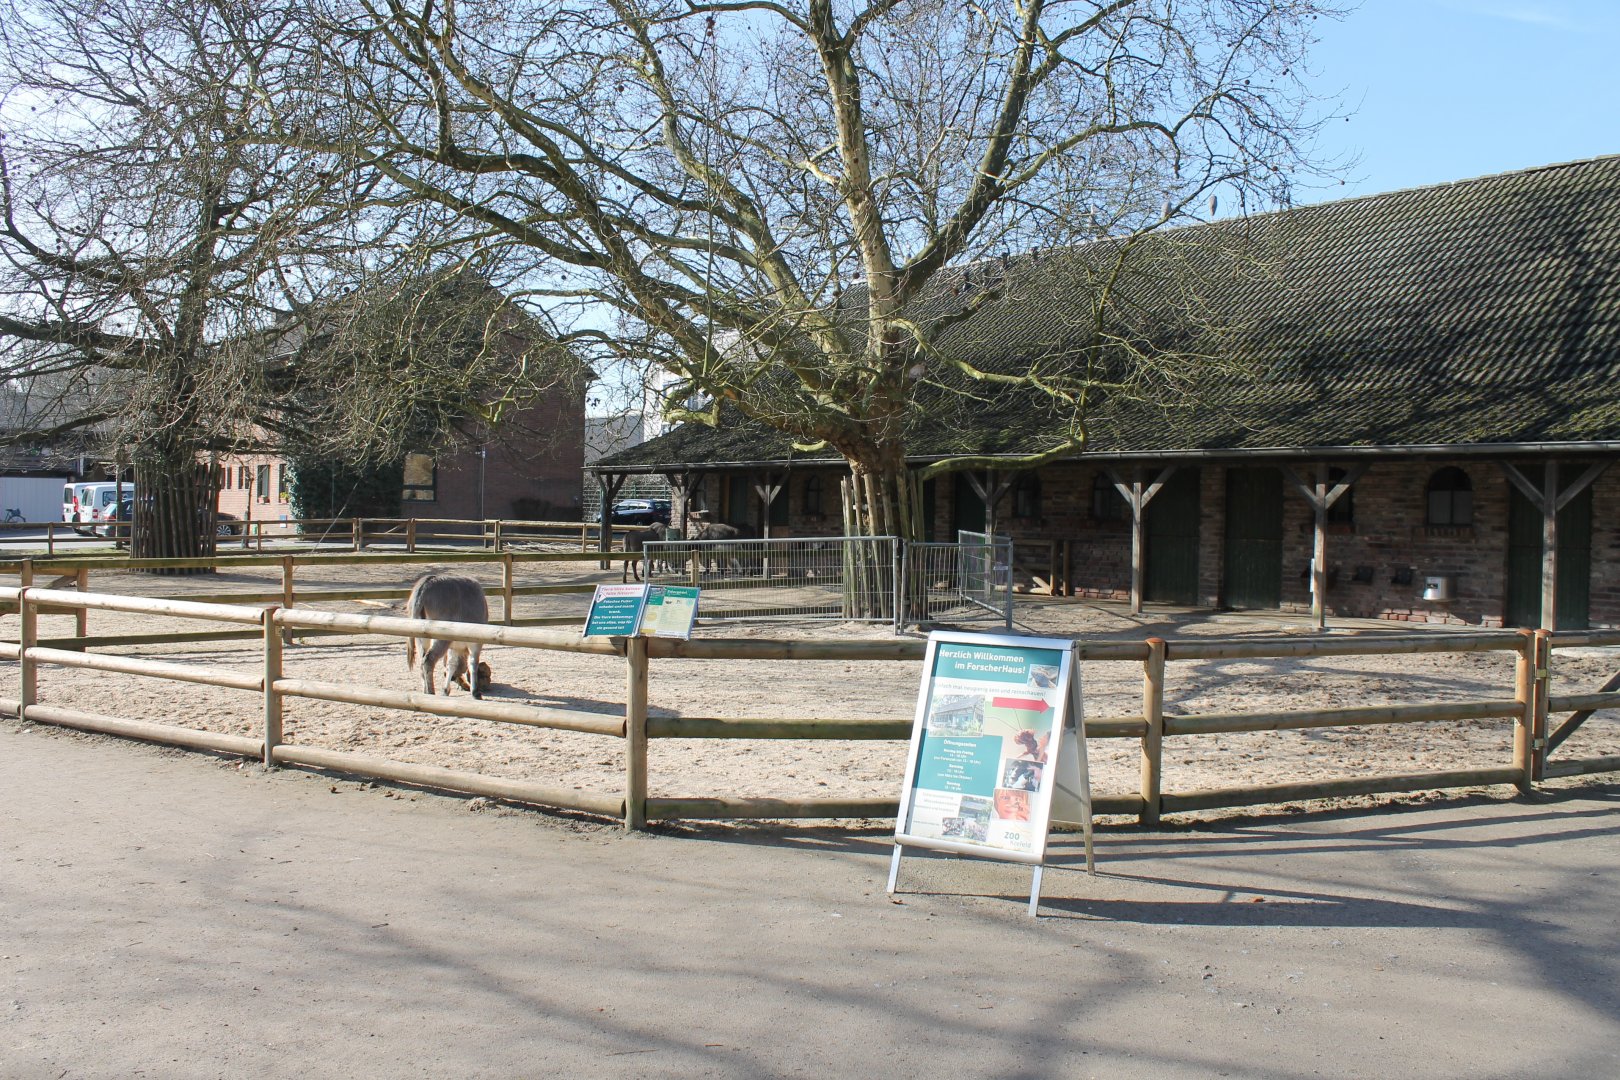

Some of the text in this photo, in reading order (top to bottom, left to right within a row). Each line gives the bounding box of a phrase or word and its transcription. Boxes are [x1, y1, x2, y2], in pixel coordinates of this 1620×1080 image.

[938, 649, 1024, 663] Herzlich Willkommen
[954, 660, 1026, 674] im ForscherHaus!
